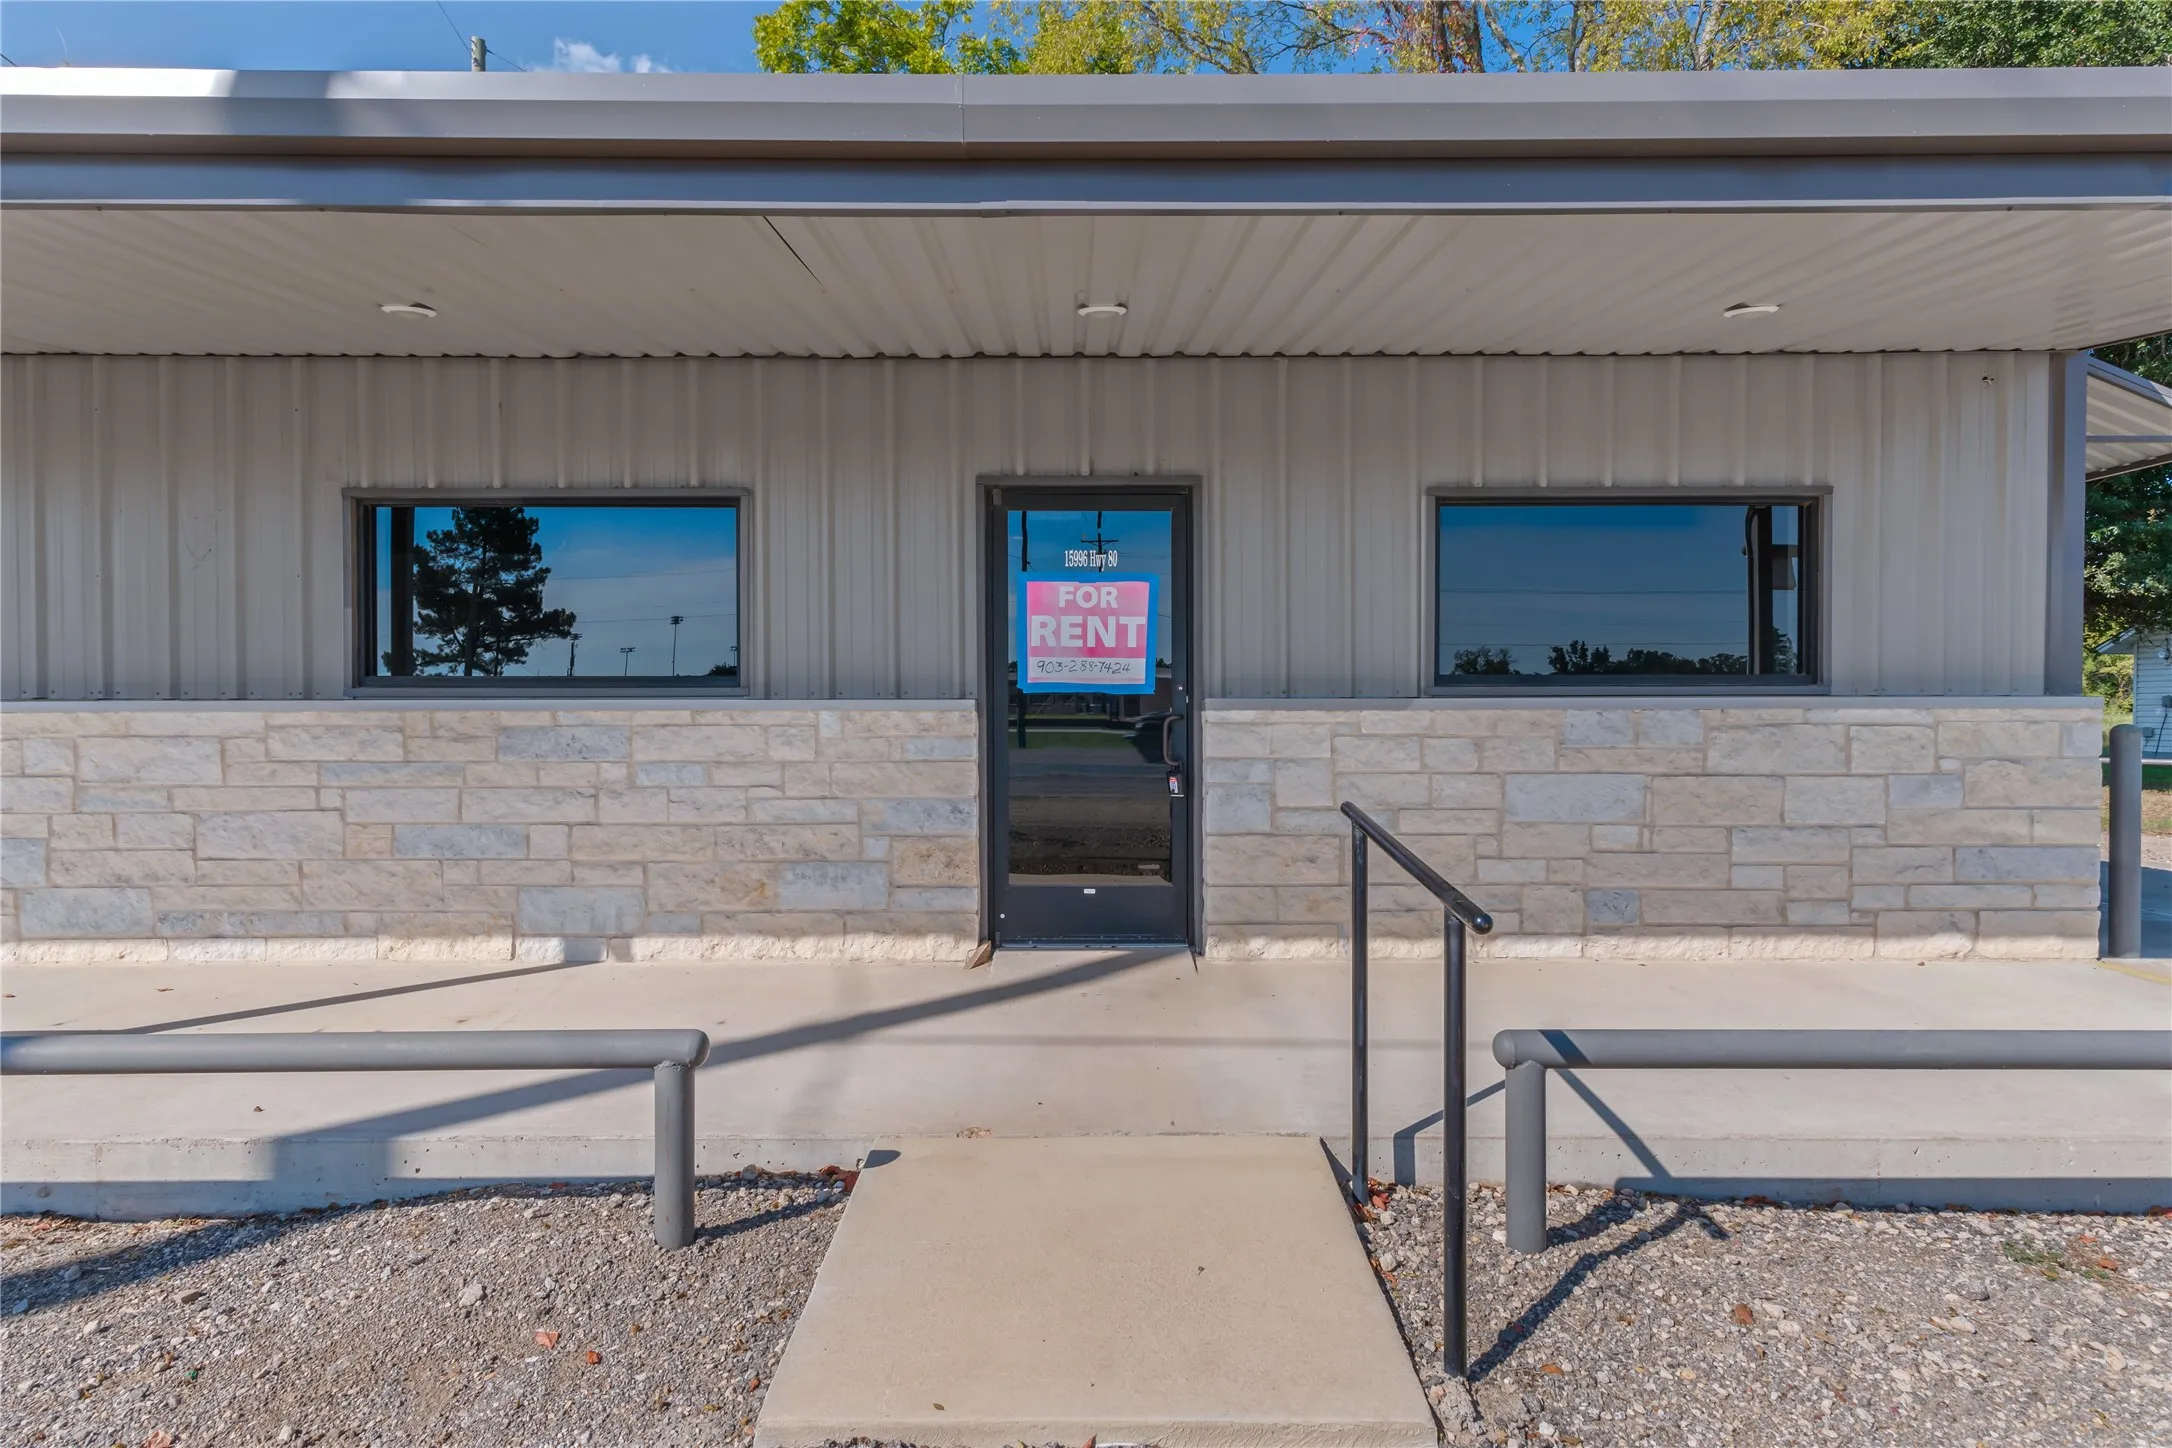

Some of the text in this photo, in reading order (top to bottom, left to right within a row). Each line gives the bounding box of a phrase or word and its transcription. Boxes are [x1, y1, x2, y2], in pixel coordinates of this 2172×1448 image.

[1064, 549, 1118, 572] 15996 Hwy 80
[1058, 585, 1119, 609] FOR
[1031, 615, 1146, 648] RENT
[1036, 660, 1131, 675] 903-288-7424
